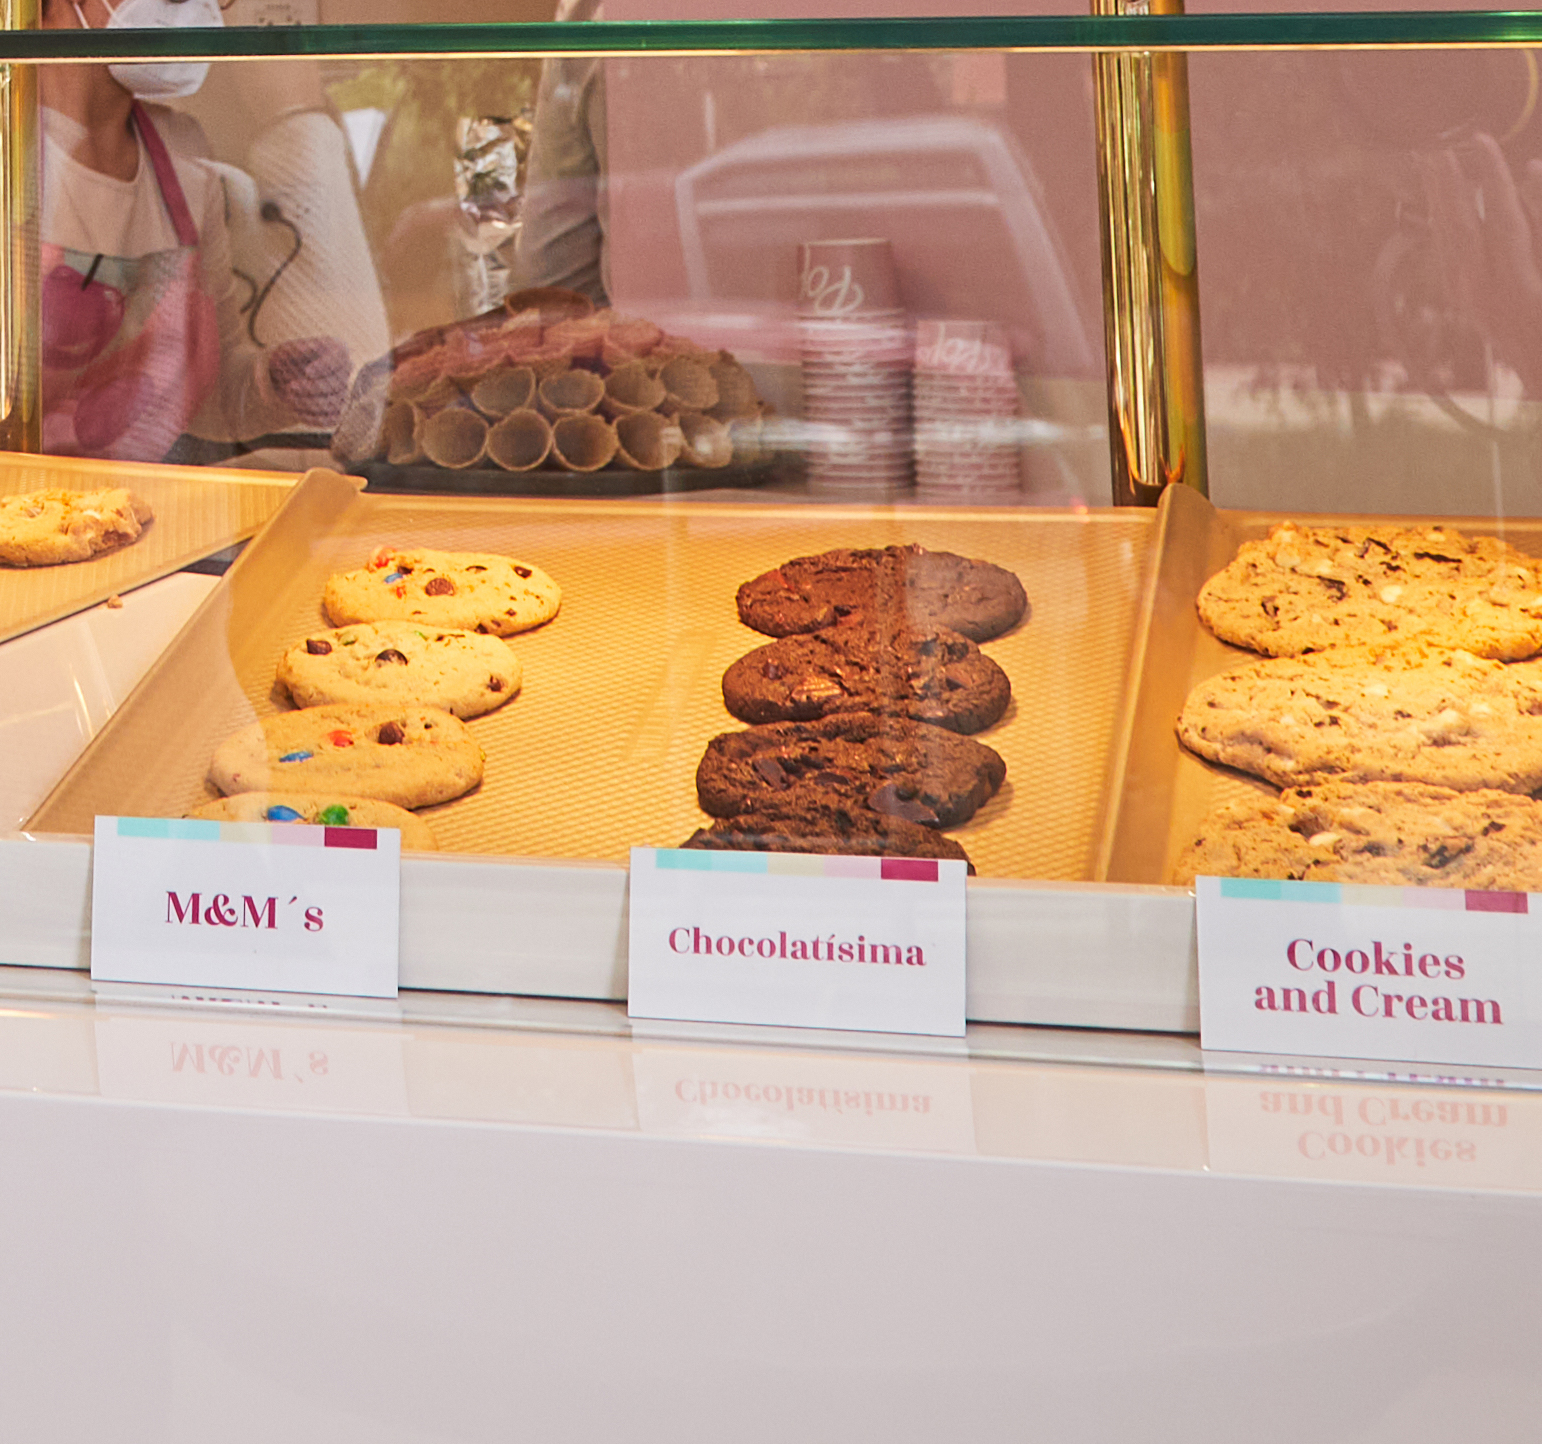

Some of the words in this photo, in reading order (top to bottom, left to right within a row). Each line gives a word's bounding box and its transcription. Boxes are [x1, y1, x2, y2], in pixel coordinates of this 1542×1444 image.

[669, 926, 927, 967] Chocolatísima
[1286, 938, 1466, 980] Cookies
[1254, 979, 1339, 1015] and
[1351, 984, 1504, 1025] Cream
